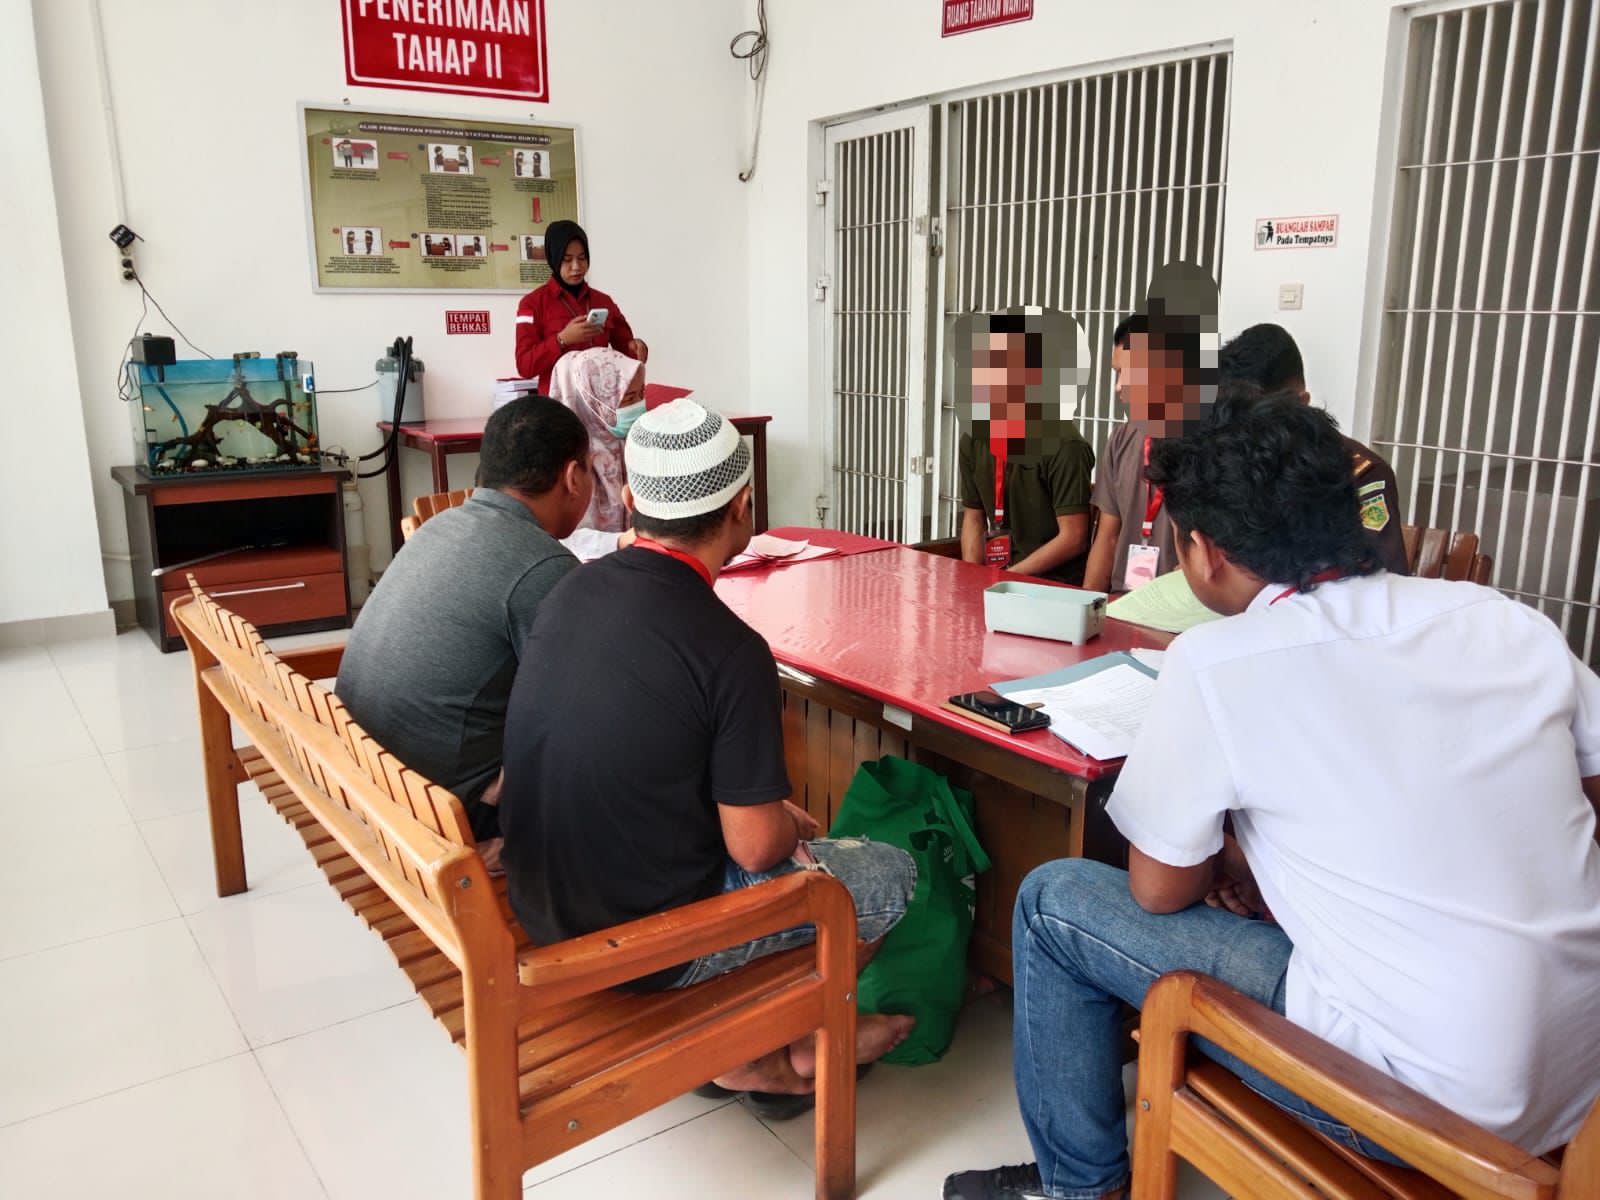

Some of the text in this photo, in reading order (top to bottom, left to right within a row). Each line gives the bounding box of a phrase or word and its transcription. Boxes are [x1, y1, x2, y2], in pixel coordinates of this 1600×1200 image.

[946, 2, 969, 28] RUANG
[970, 0, 1001, 24] TAHANAN
[392, 32, 502, 79] TAHAP II
[1310, 219, 1335, 232] SAMPAH
[1276, 234, 1334, 246] Pada Tempatnya
[449, 313, 486, 323] TEMPAT
[449, 323, 488, 332] BERKAS
